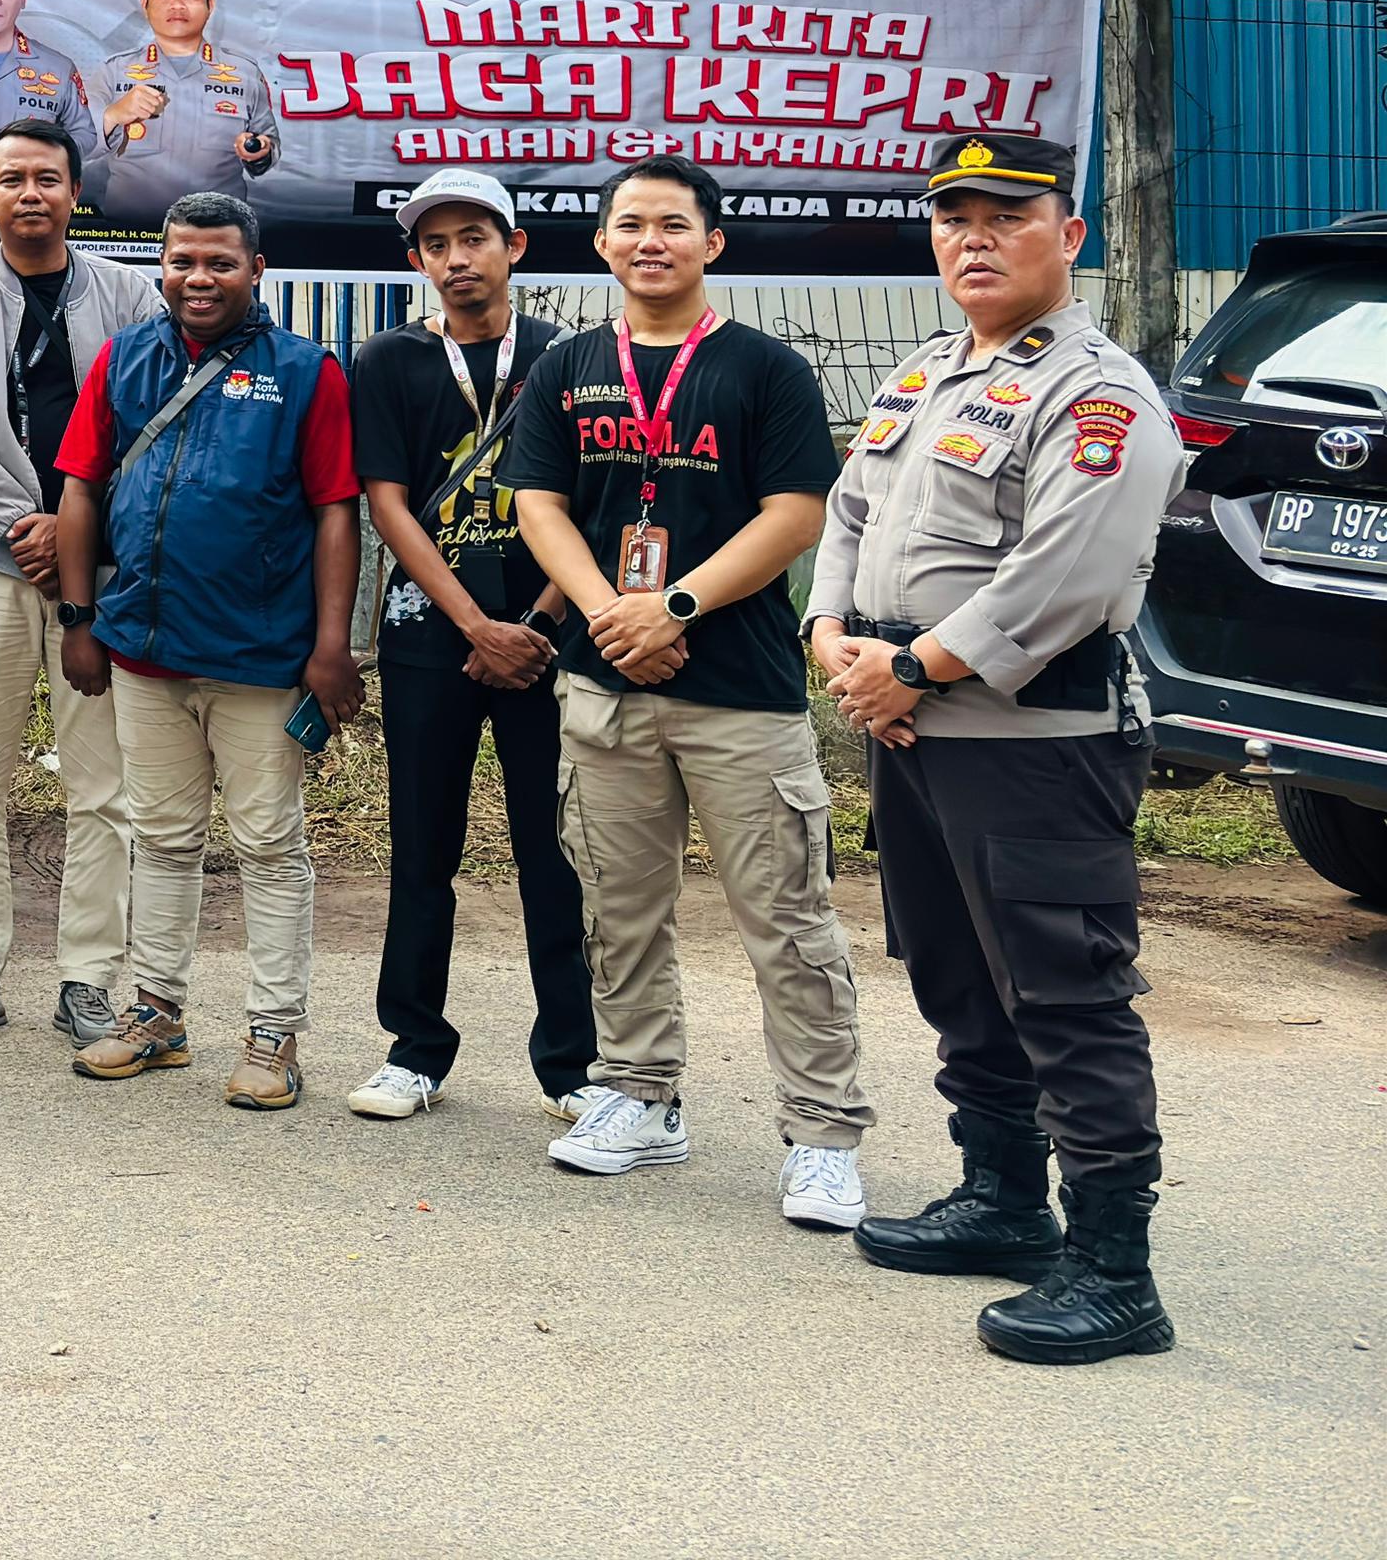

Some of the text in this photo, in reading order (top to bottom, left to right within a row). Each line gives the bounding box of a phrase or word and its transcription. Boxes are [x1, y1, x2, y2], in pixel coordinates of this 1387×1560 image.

[417, 0, 931, 59] MARI KITA
[204, 85, 243, 97] POLRI
[278, 51, 1052, 137] JAGA KEPRI
[18, 97, 59, 113] POLRI
[392, 127, 595, 163] AMAN
[606, 128, 682, 163] &
[74, 207, 94, 215] M.H.
[69, 229, 163, 241] Kombes Pol. H. Omp
[129, 245, 163, 253] BARELA
[256, 373, 274, 384] KPU
[255, 383, 279, 393] KOTA
[574, 385, 629, 398] BAWASL
[253, 392, 284, 405] BATAM
[956, 402, 1016, 431] POLRI
[691, 424, 719, 460] A
[658, 457, 718, 472] engawasan
[1276, 496, 1315, 533] BP
